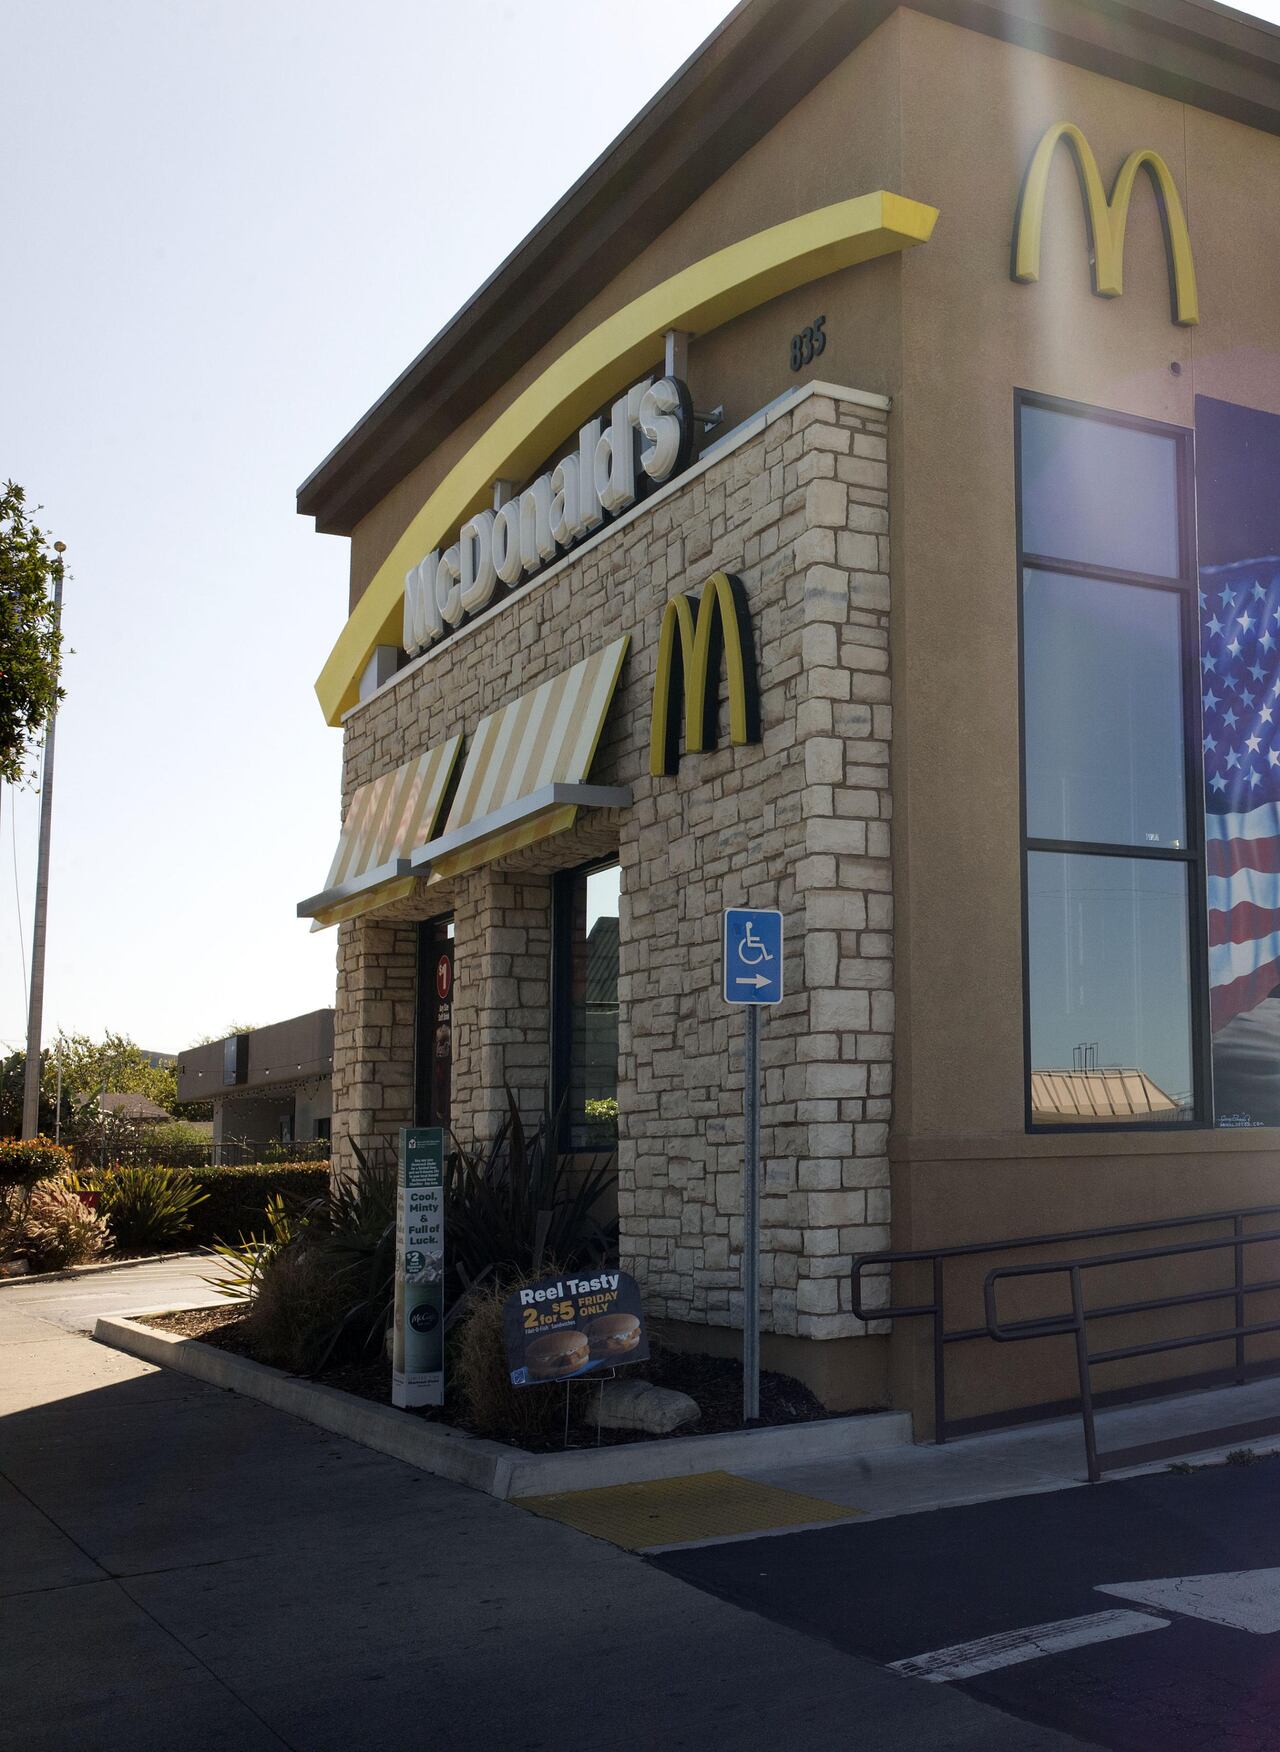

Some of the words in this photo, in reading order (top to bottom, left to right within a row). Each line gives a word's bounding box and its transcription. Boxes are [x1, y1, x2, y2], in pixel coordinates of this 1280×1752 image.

[790, 315, 826, 372] 835
[403, 378, 690, 659] McDonald's
[411, 1192, 437, 1201] Cool,
[409, 1203, 439, 1213] Minty
[420, 1214, 428, 1222] &
[408, 1225, 429, 1234] Full
[429, 1224, 440, 1233] of
[409, 1235, 438, 1245] Luck.
[520, 1282, 563, 1305] Reel
[567, 1274, 619, 1295] Tasty
[578, 1291, 619, 1307] FRIDAY
[523, 1308, 539, 1329] 2
[540, 1314, 558, 1326] for
[552, 1300, 576, 1320] $5
[579, 1303, 609, 1317] ONLY
